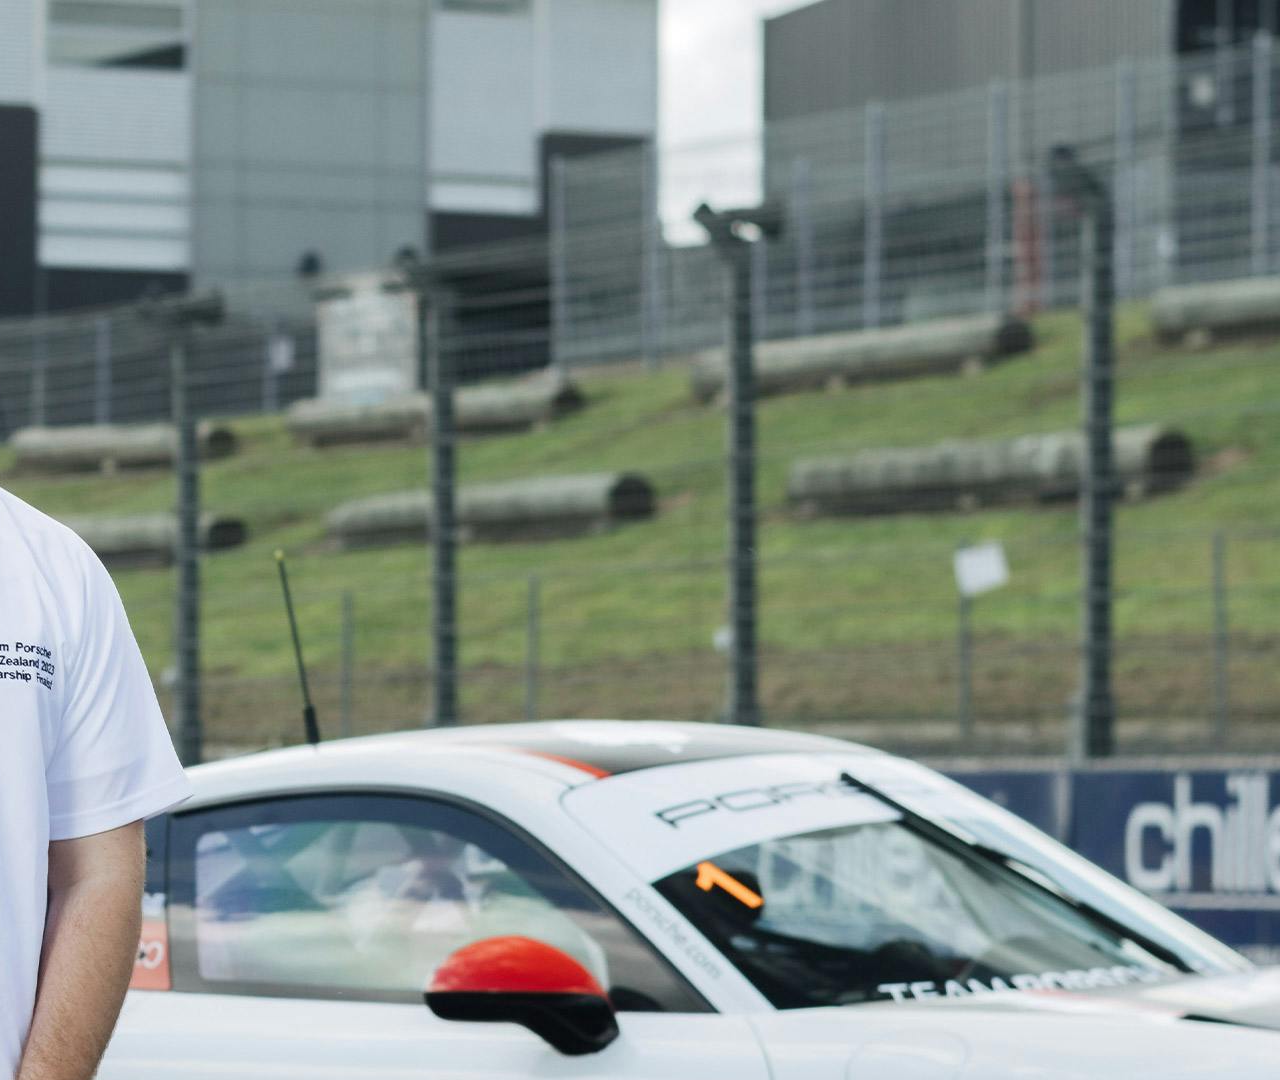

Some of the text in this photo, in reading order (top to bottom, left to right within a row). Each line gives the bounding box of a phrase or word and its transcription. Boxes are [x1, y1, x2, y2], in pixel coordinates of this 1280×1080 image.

[15, 641, 52, 659] Porsche
[0, 655, 40, 669] Zealand
[41, 660, 55, 676] 2023
[696, 860, 763, 909] 1
